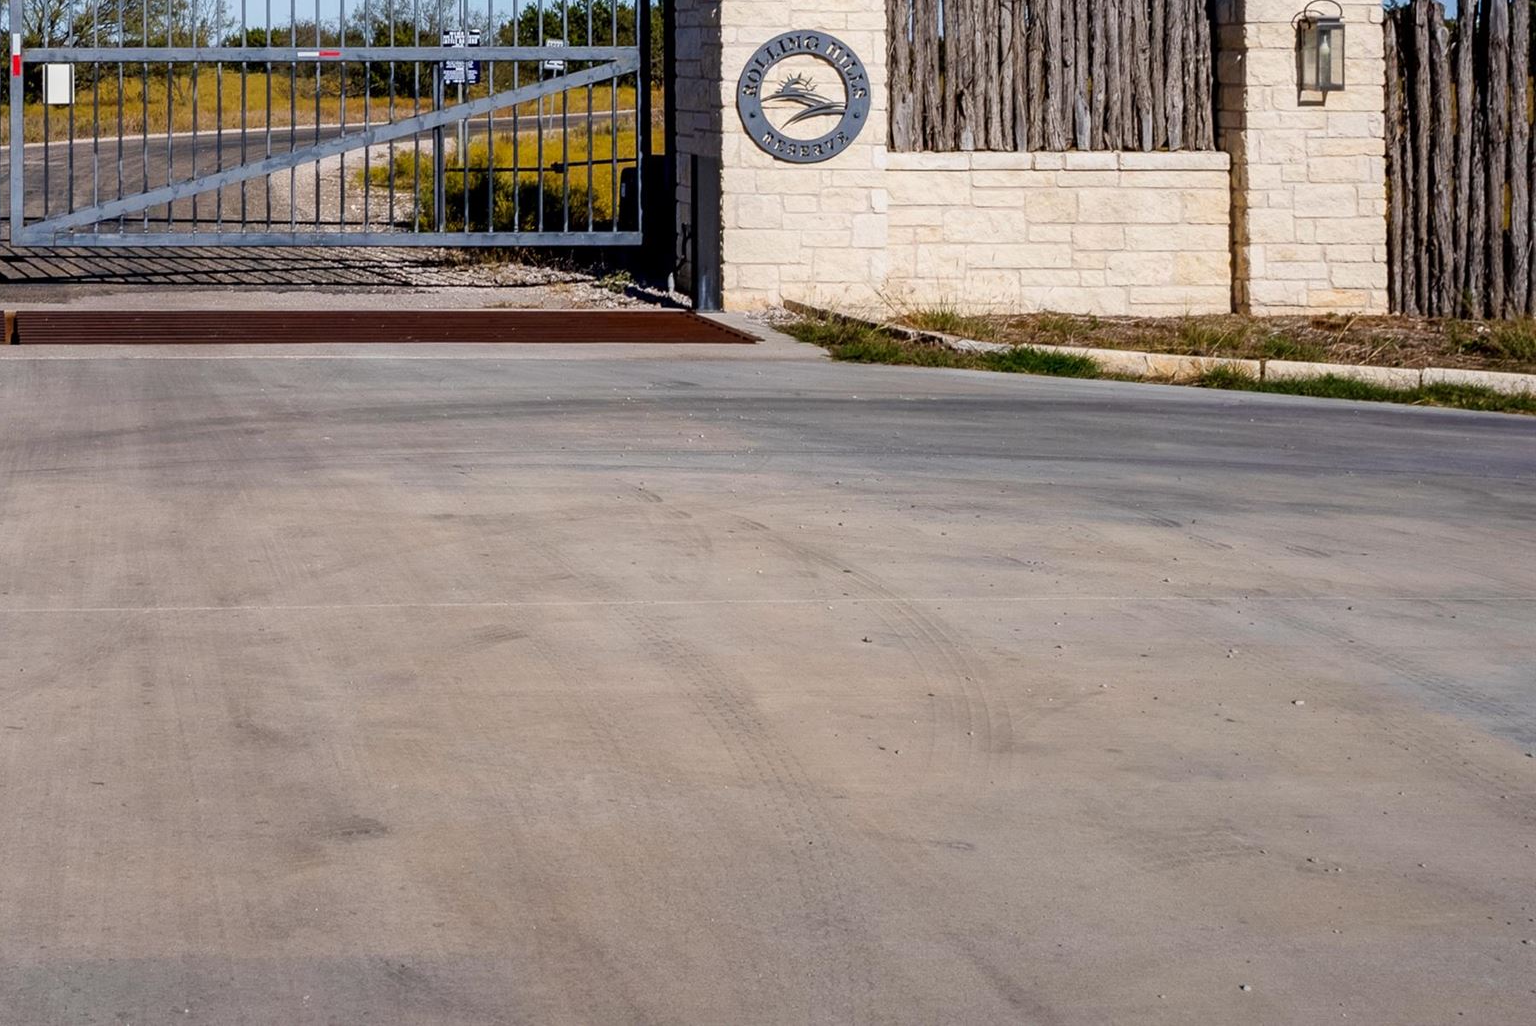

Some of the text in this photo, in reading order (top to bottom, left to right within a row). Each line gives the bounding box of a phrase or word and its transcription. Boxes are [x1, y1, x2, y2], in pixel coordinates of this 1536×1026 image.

[742, 35, 868, 100] ROLLING HILLS
[762, 131, 850, 158] RESERVE
